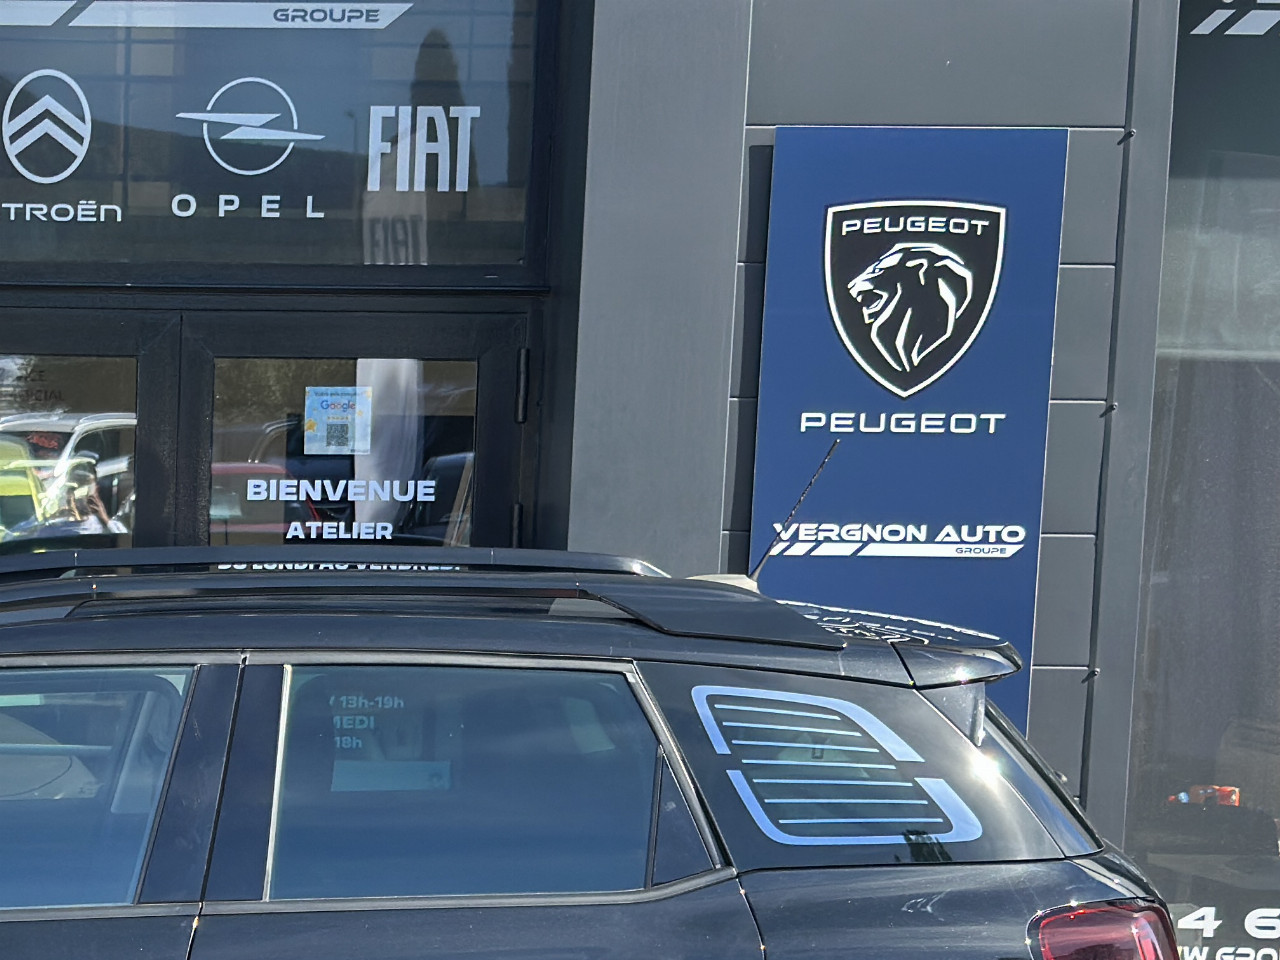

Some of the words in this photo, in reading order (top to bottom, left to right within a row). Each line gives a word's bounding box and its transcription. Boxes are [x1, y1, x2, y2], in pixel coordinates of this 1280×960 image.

[273, 8, 380, 23] GROUPE
[367, 105, 481, 192] FIAT
[171, 193, 325, 218] OPEL
[841, 216, 990, 236] PEUGEOT
[320, 400, 357, 412] Google
[800, 412, 1007, 434] PEUGEOT
[246, 478, 437, 502] BIENVENUE
[285, 521, 394, 540] ATELIER
[772, 523, 927, 542] VERGNON
[934, 524, 1027, 543] AUTO
[955, 547, 1008, 555] GROUPE
[340, 695, 405, 709] 13h-19h
